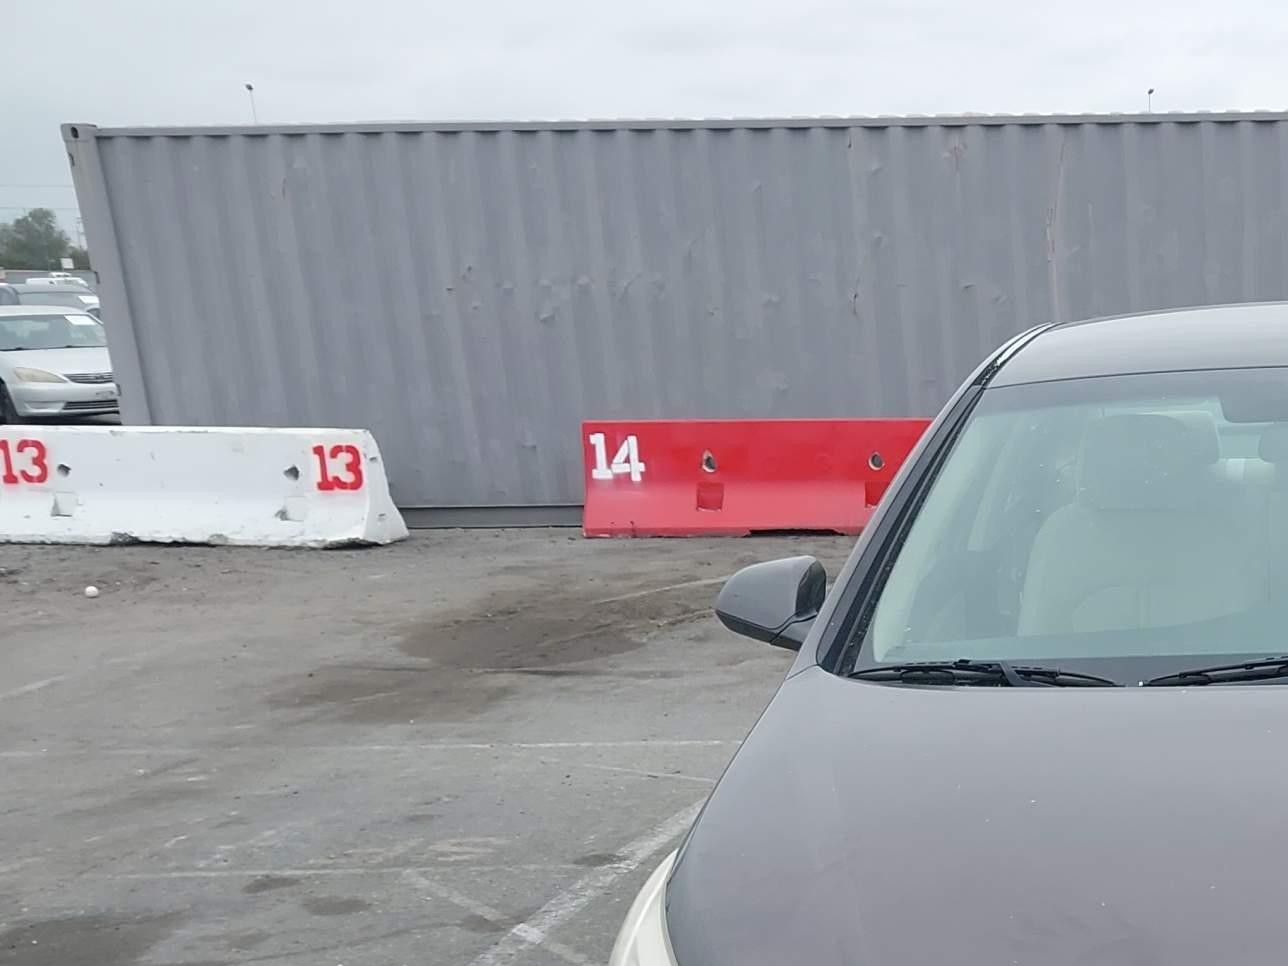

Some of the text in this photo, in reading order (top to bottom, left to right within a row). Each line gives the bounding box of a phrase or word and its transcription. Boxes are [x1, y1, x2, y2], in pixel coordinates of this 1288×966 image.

[0, 439, 49, 485] 13
[312, 444, 364, 492] 13
[588, 432, 645, 482] 14
